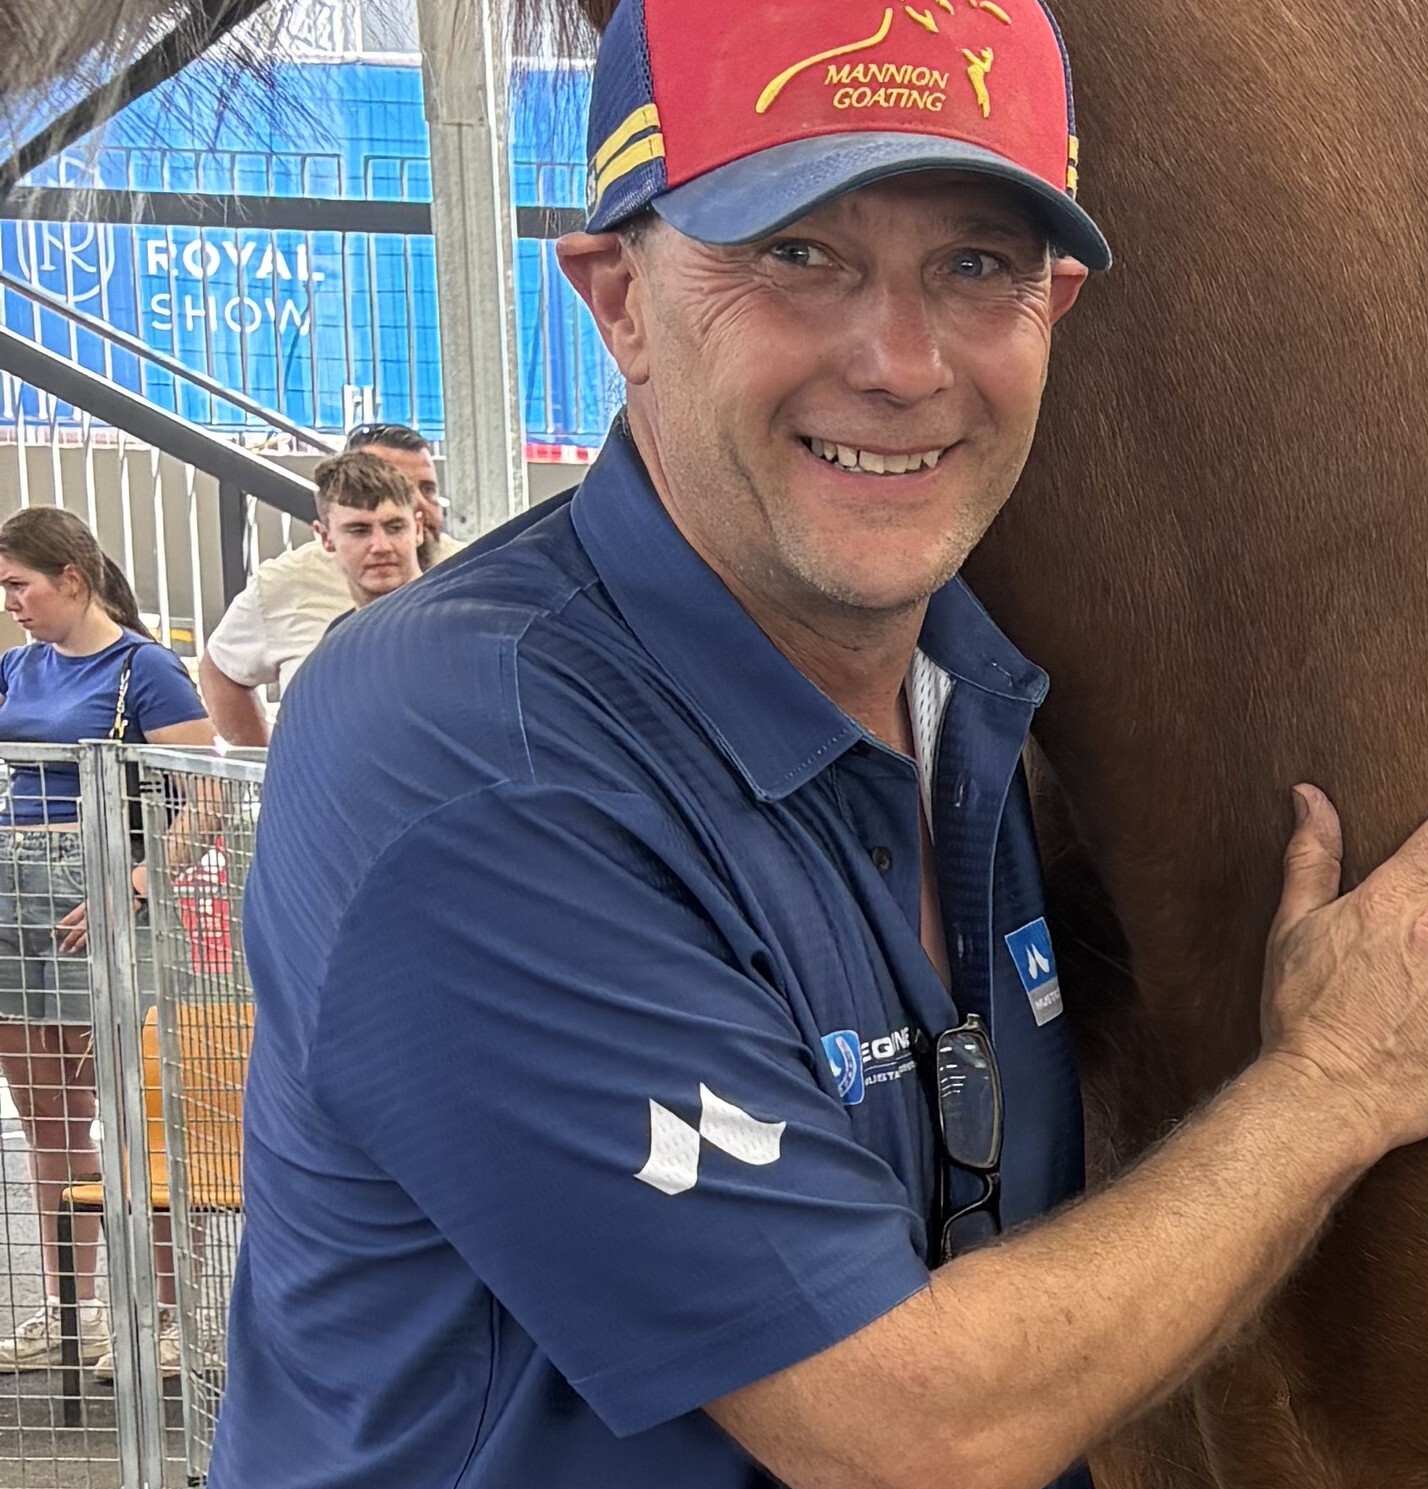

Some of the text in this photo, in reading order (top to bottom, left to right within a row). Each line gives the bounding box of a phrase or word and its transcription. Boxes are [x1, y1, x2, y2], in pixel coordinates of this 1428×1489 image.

[824, 63, 949, 89] MANNION
[833, 87, 946, 112] GOATING
[146, 239, 325, 282] ROYAL
[151, 293, 311, 336] SHOW
